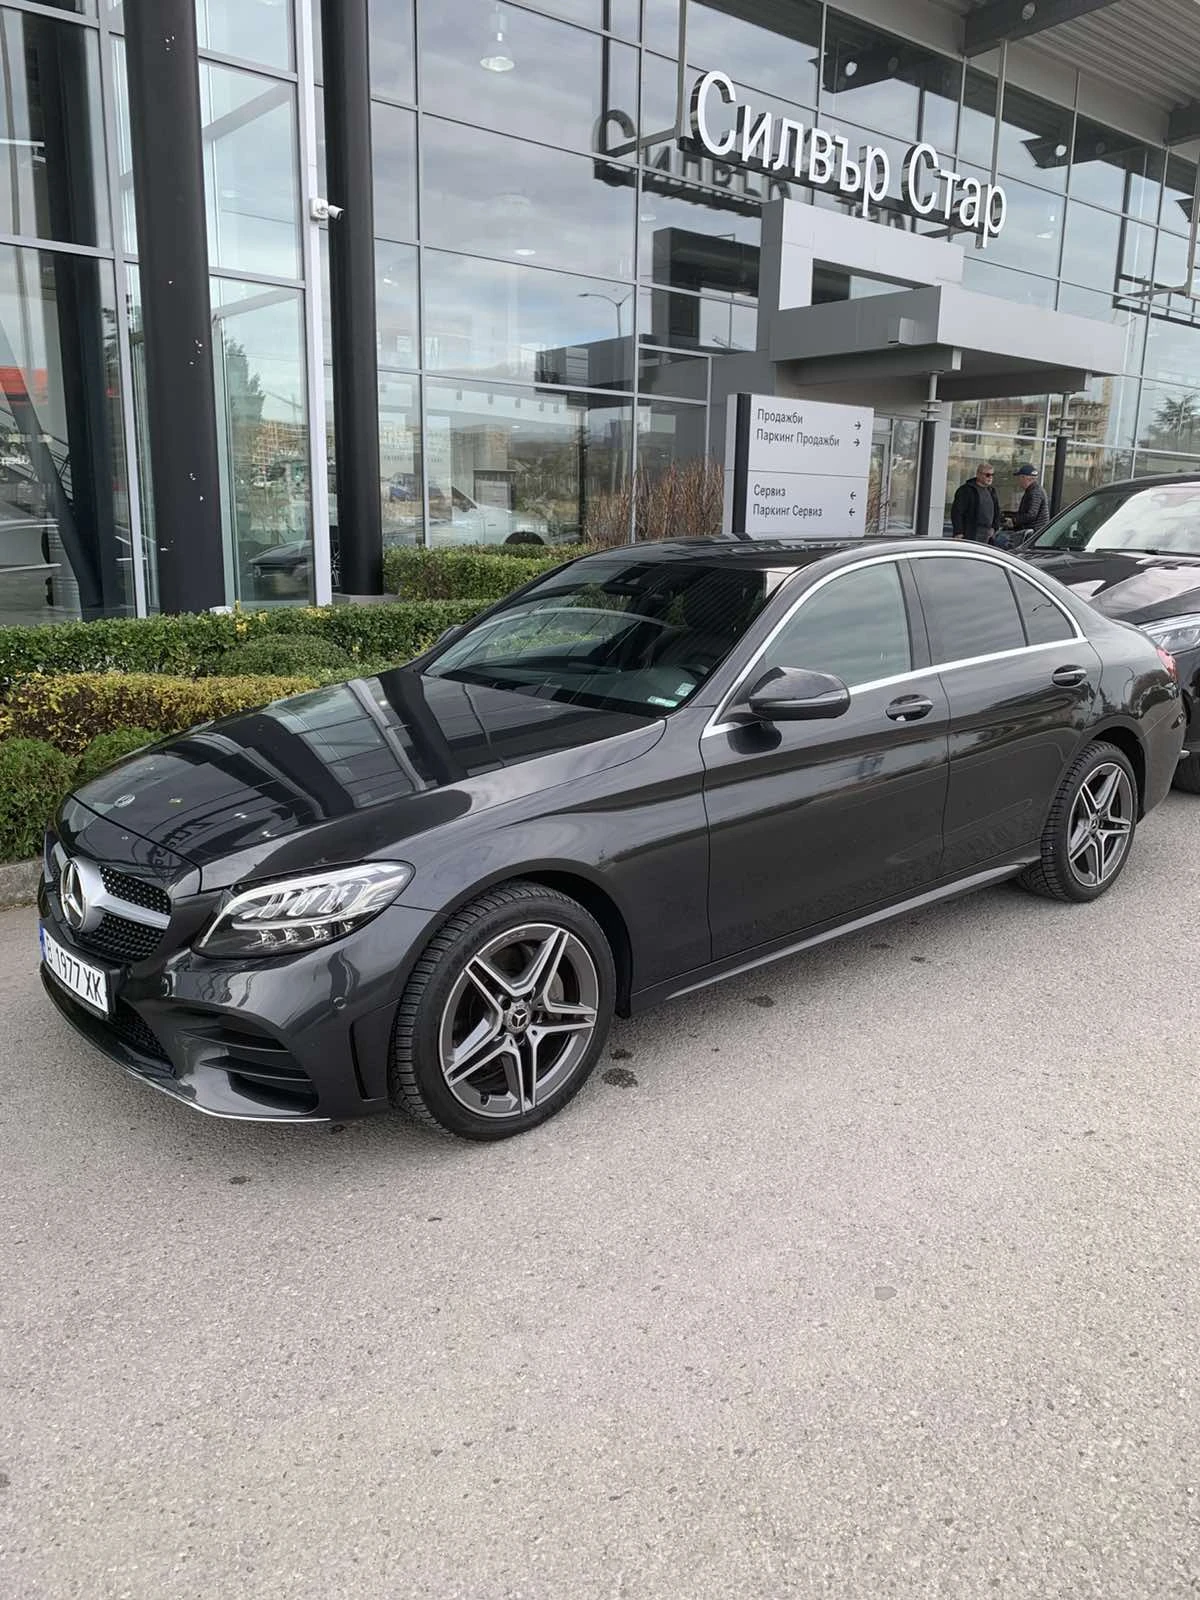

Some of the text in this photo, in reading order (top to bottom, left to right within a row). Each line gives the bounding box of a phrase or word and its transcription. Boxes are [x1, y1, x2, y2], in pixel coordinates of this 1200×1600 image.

[692, 70, 890, 217] Силвър
[905, 143, 1008, 248] Стар
[757, 408, 804, 424] Продажби
[756, 428, 840, 447] Паркинг Продажби
[753, 483, 787, 499] Сервиз
[752, 503, 823, 520] Паркинг Сервиз
[56, 946, 80, 989] 1977
[83, 966, 104, 1006] XK
